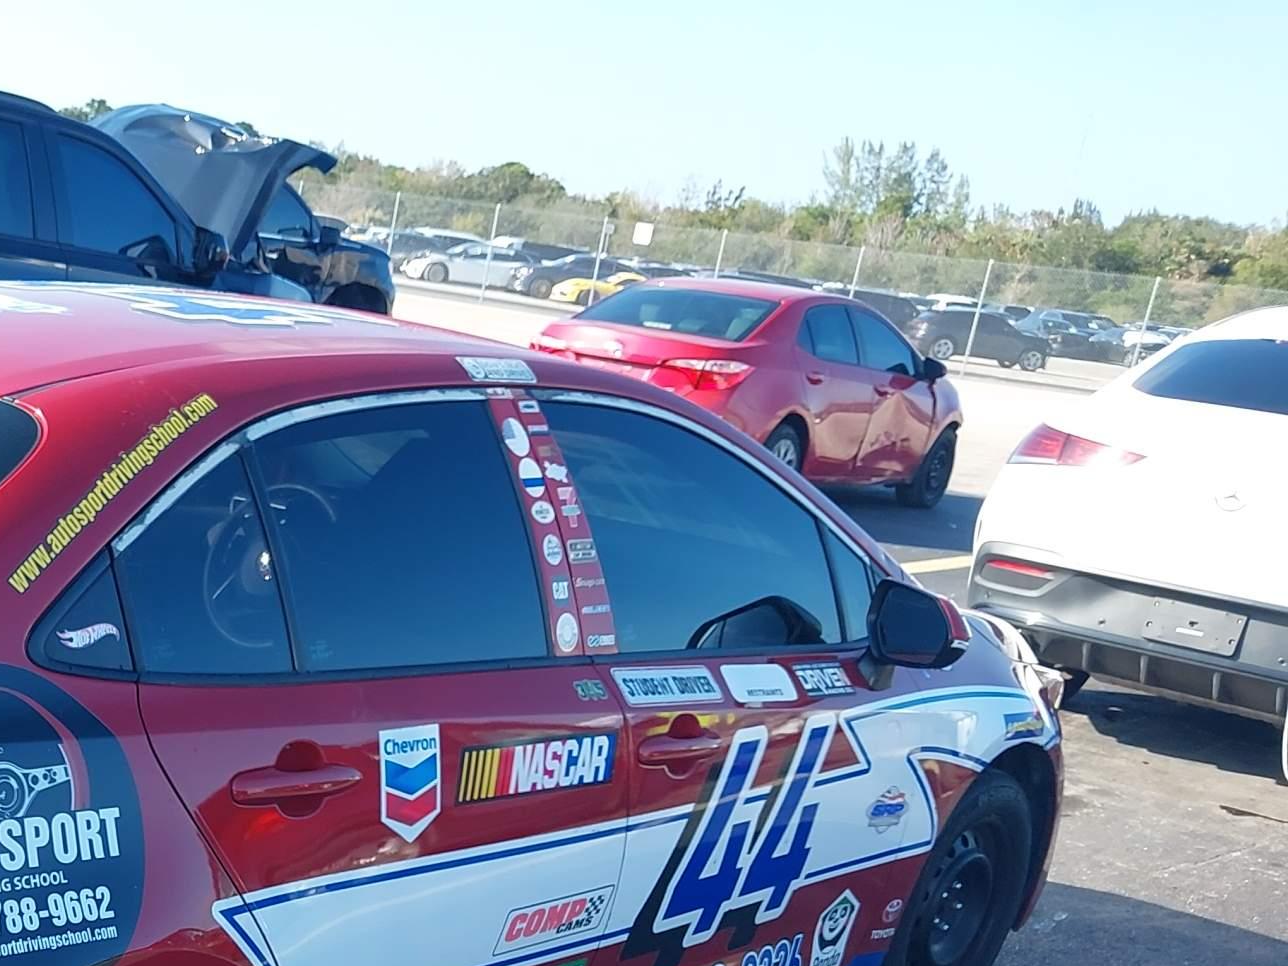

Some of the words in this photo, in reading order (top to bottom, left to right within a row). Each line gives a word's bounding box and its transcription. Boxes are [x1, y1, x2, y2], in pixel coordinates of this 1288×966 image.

[8, 393, 218, 594] www.autosportdrivingschool.com
[552, 581, 569, 599] CAT
[622, 676, 671, 697] STUDENT
[672, 675, 716, 696] DRIVER
[383, 735, 437, 755] Chevron
[509, 733, 610, 796] NASCAR
[653, 713, 839, 948] 44
[14, 870, 68, 891] SCHOOL
[505, 898, 587, 942] COMP
[556, 915, 594, 934] CAMS
